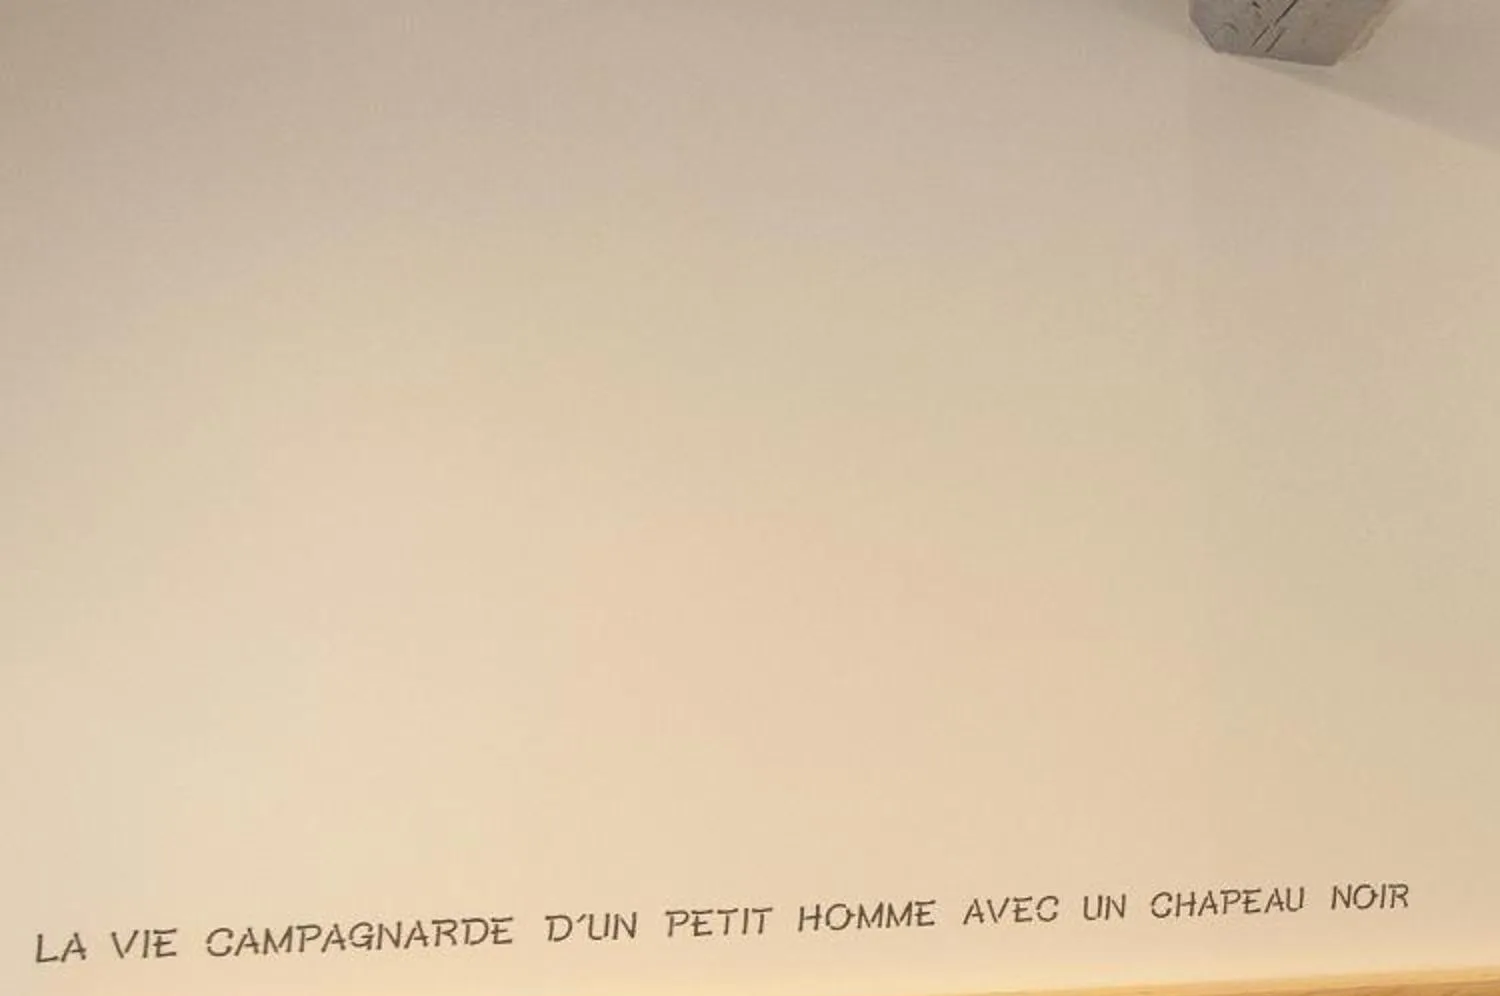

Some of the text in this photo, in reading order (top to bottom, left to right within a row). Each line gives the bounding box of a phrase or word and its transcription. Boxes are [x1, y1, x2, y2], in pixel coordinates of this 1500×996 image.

[35, 882, 1410, 963] LA VIE CAMPAGNARDE D'UN PETIT HOMME AVEC UN CHAPEAU NOIR
